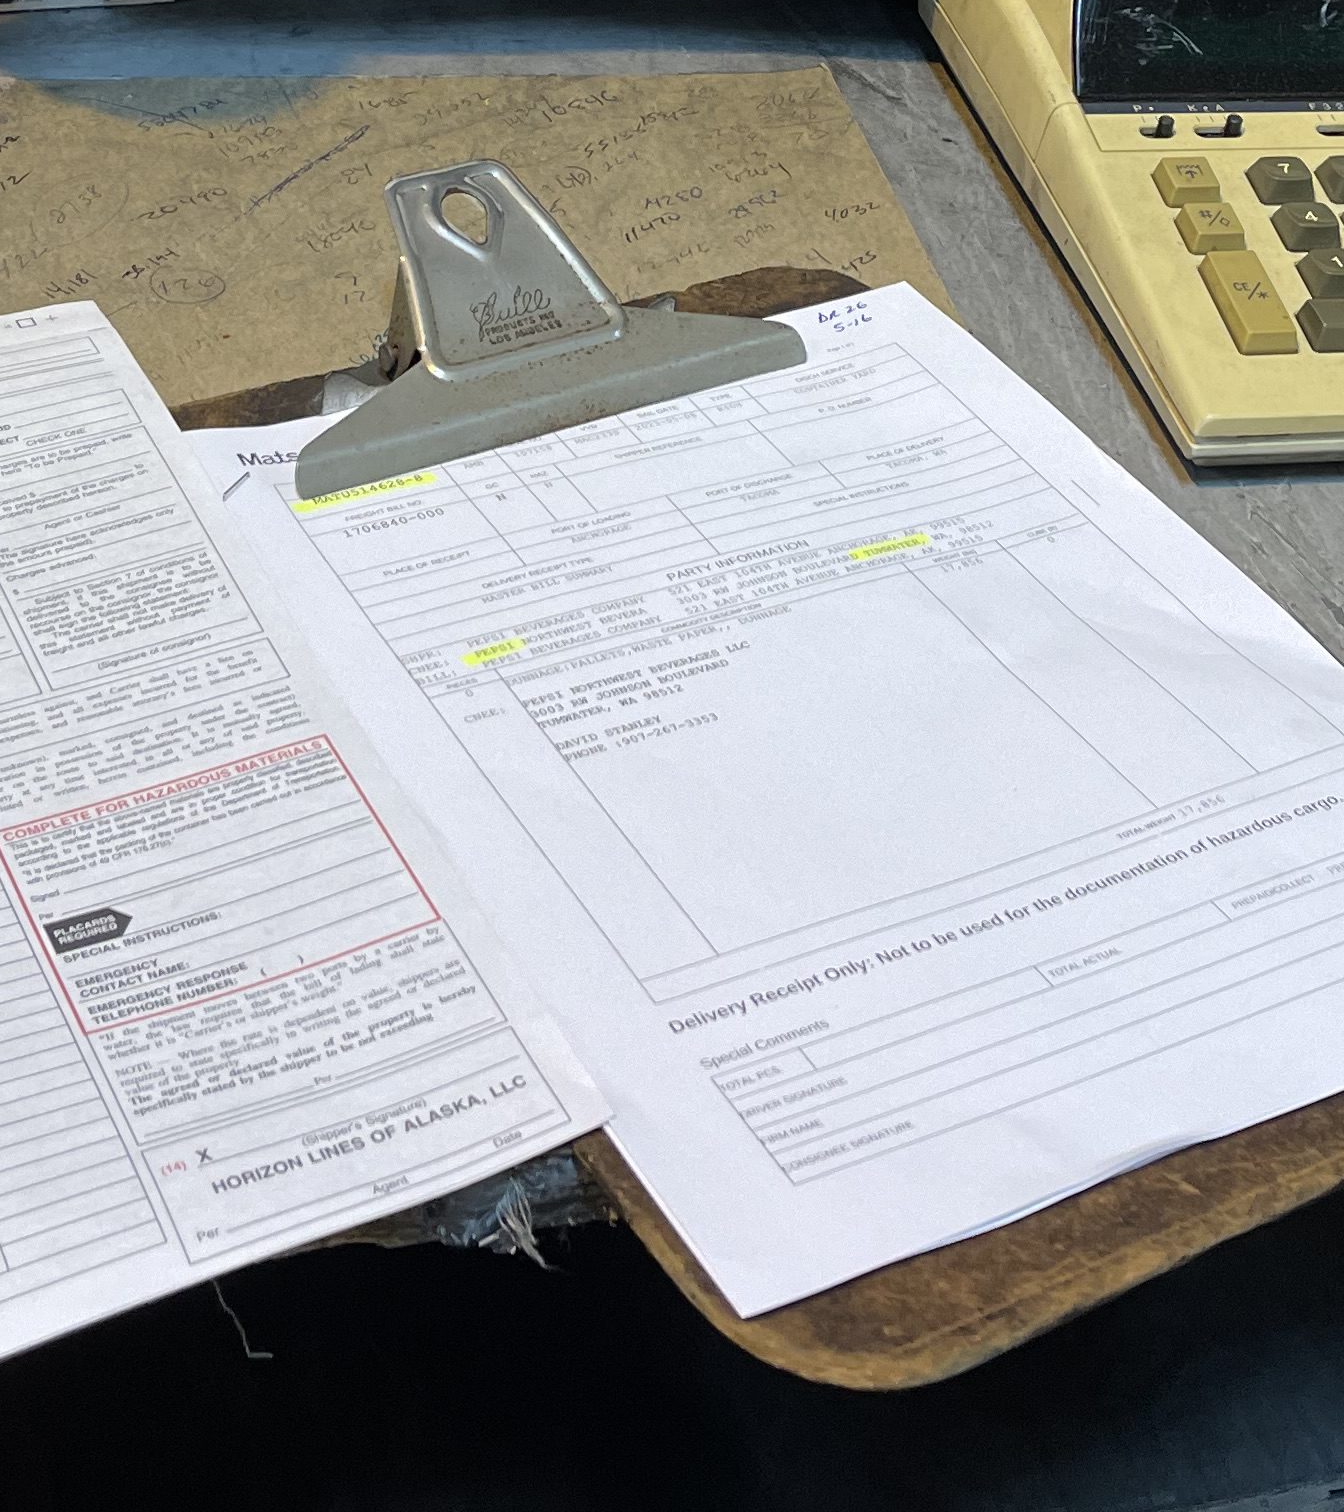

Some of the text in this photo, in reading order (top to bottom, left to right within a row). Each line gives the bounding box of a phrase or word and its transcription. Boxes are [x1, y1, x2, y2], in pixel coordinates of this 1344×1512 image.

[1277, 162, 1291, 175] 7
[1304, 210, 1318, 222] 4
[1331, 255, 1344, 268] 1
[666, 539, 810, 583] PARTY INFORMATION
[522, 690, 564, 709] PEPSI
[2, 739, 323, 843] COMPLETE FOR HAZARDOUS MATERIALS
[668, 1000, 749, 1036] Delivery
[749, 975, 824, 1008] Receipt
[875, 945, 911, 966] Not
[911, 936, 932, 953] to
[933, 926, 958, 946] be
[959, 912, 1005, 939] used
[1003, 903, 1031, 923] for
[1032, 891, 1063, 913] the
[1064, 846, 1189, 902] documentation
[1189, 838, 1209, 855] of
[1207, 809, 1294, 850] hazardous
[1293, 791, 1344, 819] cargo.
[699, 1018, 830, 1071] Special Comments
[211, 1074, 528, 1194] HORIZON LINES OF ALASKA, LLC
[195, 1147, 213, 1163] X
